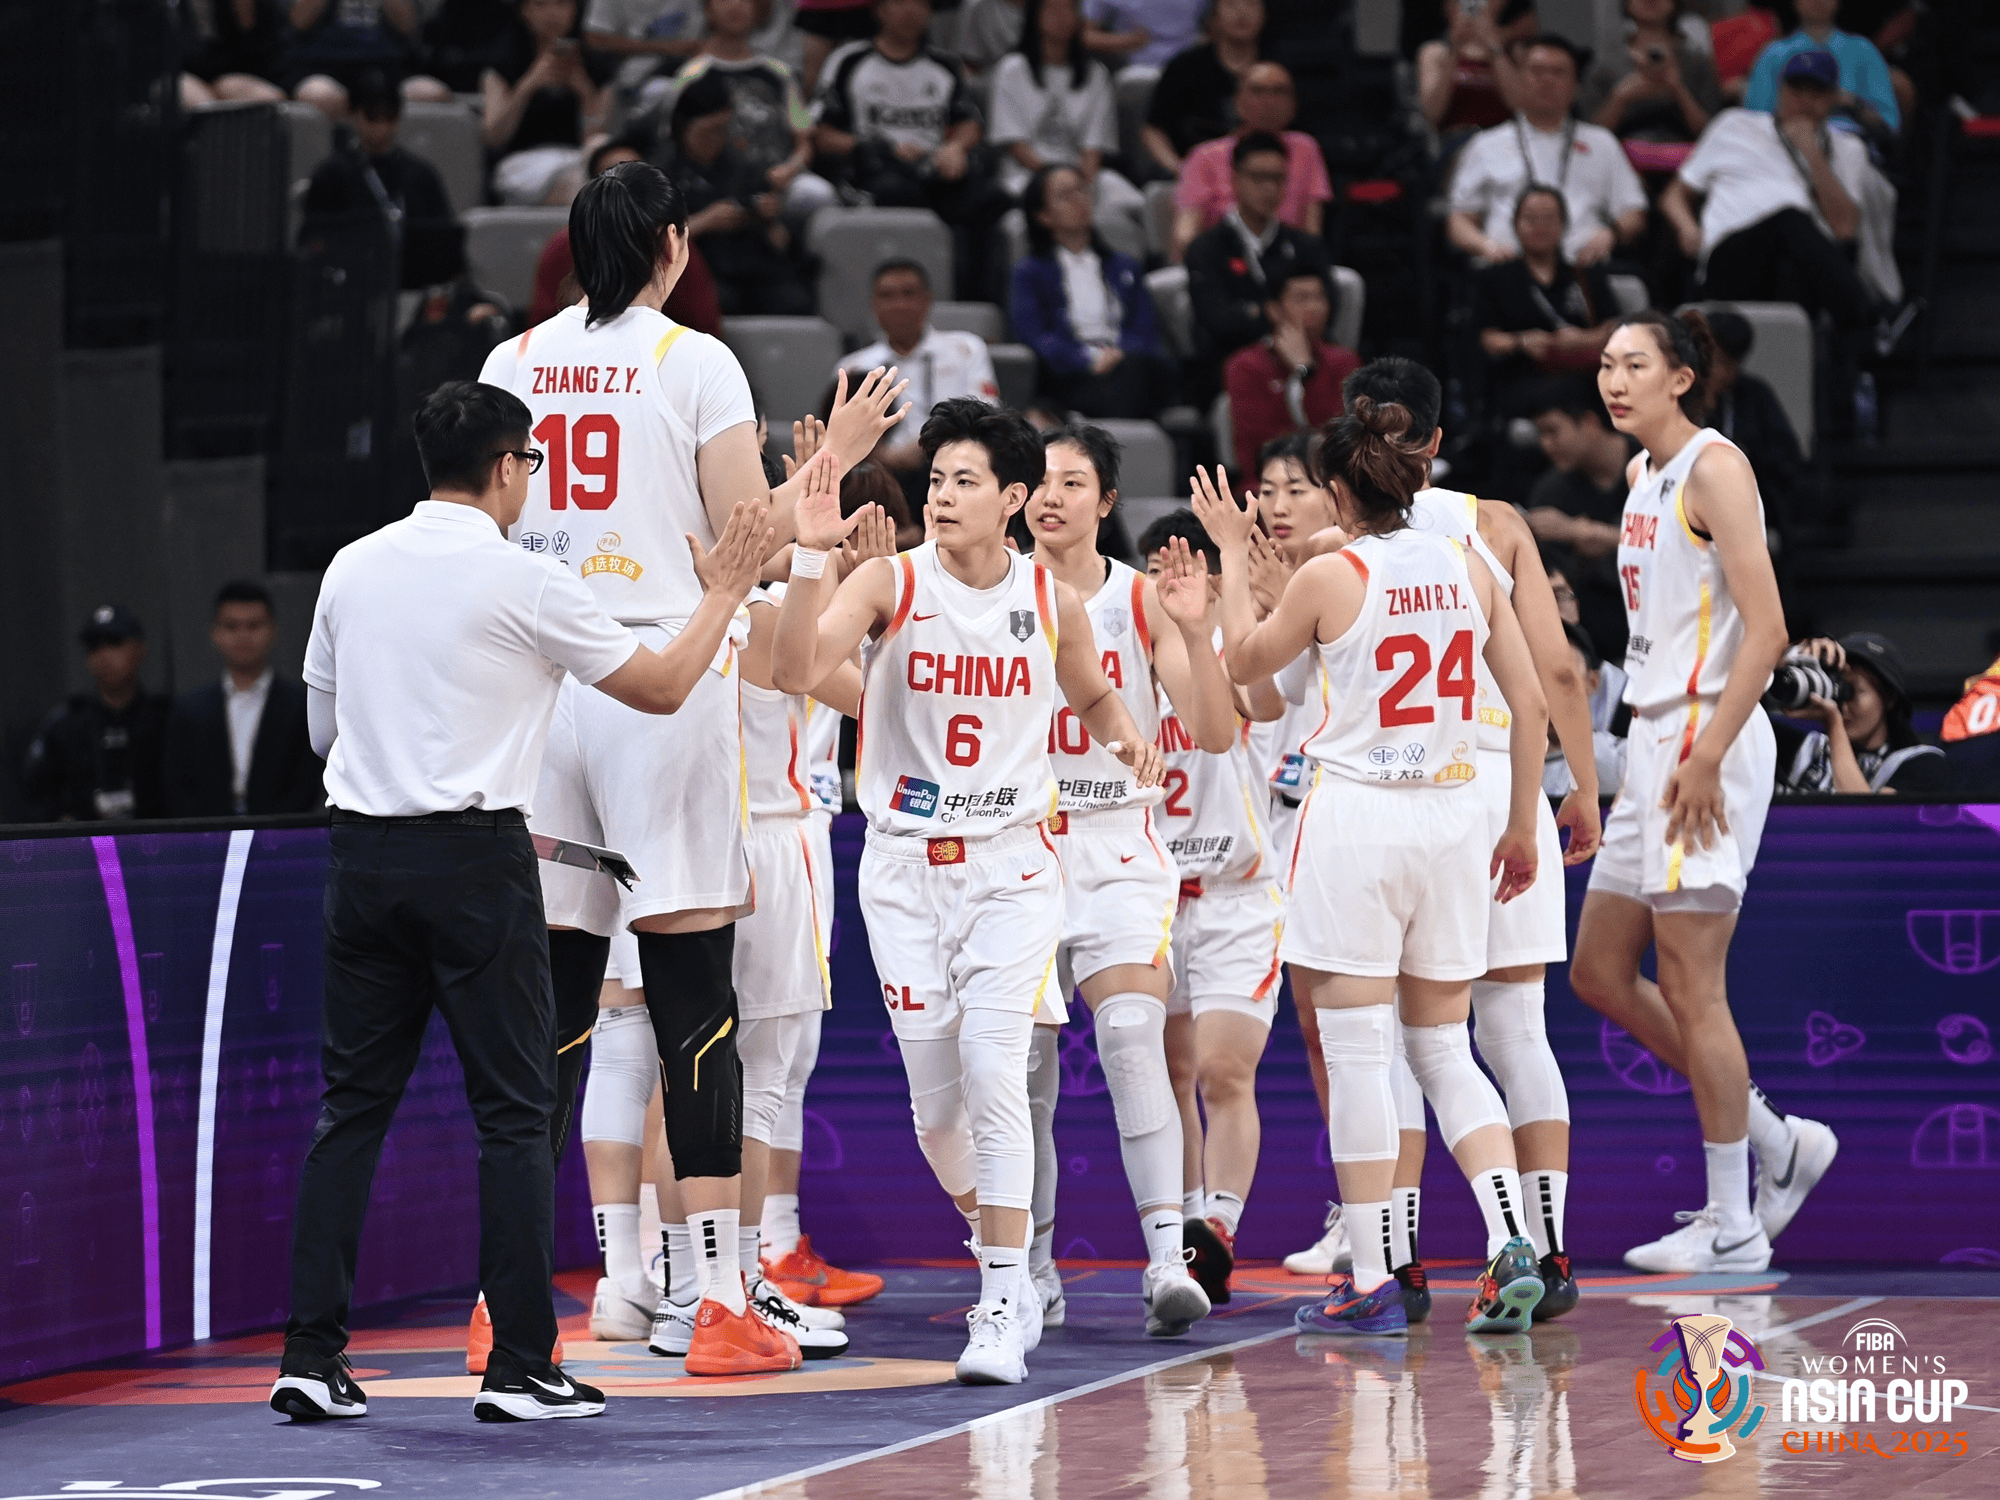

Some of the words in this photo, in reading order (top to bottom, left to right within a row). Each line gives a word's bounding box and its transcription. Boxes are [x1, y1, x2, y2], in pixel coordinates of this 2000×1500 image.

[532, 366, 599, 394] ZHANG
[532, 414, 620, 511] 19
[1386, 585, 1432, 616] ZHAI
[908, 651, 1031, 697] CHINA
[1375, 630, 1476, 728] 24
[945, 714, 983, 767] 6
[897, 783, 937, 804] UnionPay
[1058, 779, 1127, 799] 中国银联
[909, 798, 933, 812] 银联
